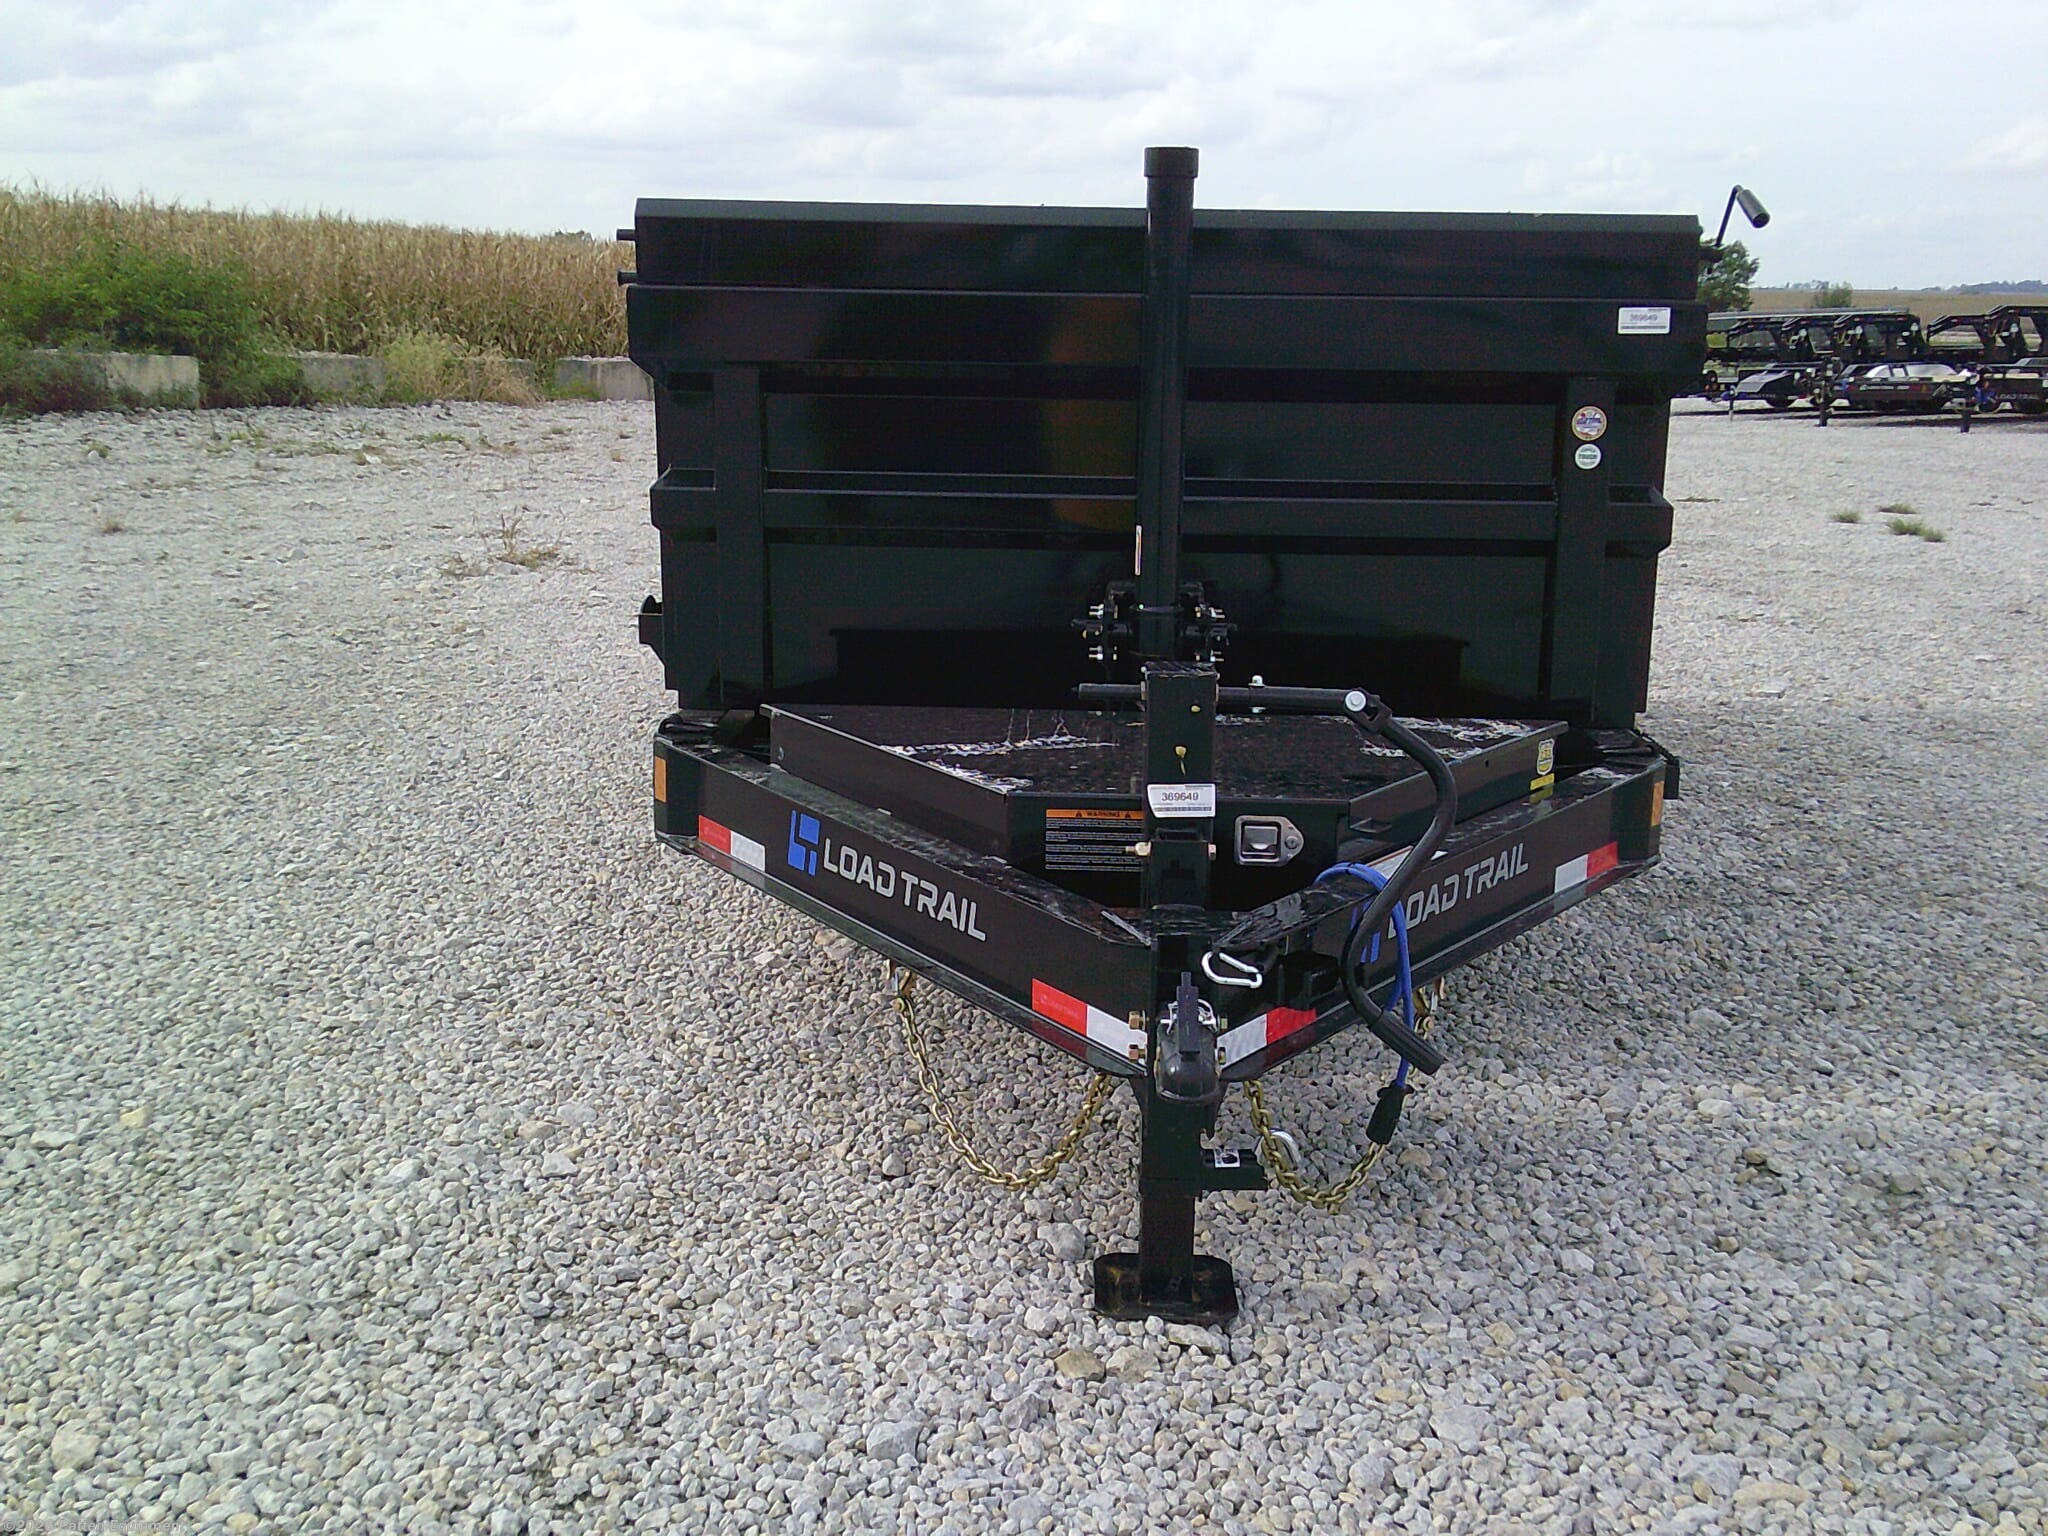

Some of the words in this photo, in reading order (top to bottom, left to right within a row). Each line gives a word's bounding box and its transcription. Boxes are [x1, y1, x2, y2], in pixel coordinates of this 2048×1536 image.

[1161, 791, 1199, 801] 369649
[823, 837, 896, 898] LOAD
[901, 871, 986, 942] TRAIL
[1464, 842, 1529, 899] TRAIL
